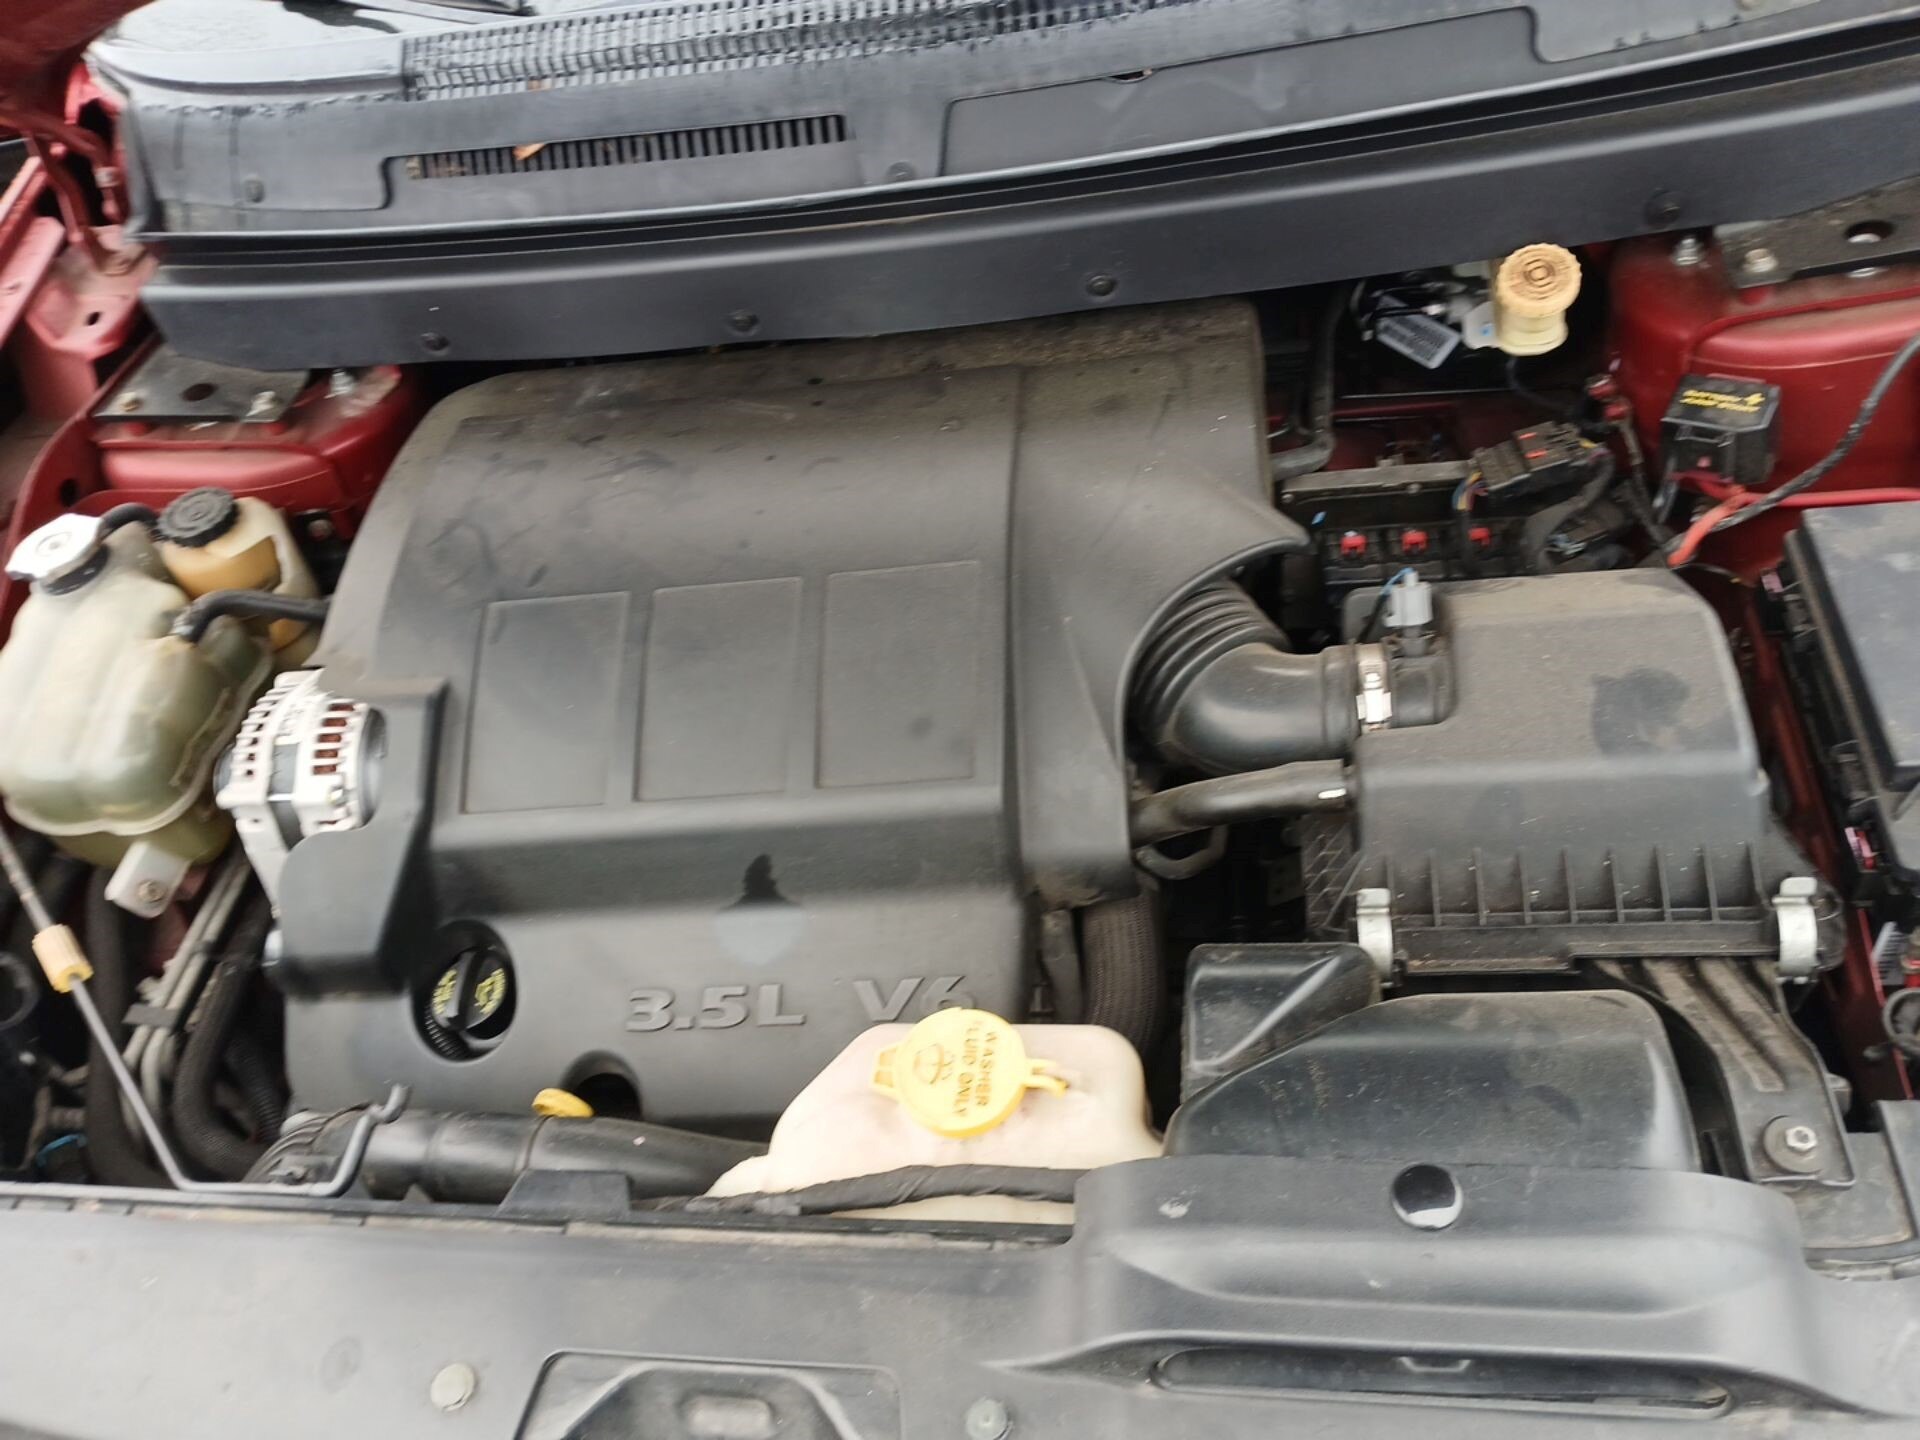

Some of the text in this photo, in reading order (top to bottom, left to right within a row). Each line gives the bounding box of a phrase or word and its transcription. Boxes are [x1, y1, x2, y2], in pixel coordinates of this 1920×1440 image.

[625, 975, 975, 1033] 3.5L V6
[953, 1072, 976, 1118] ONLY
[975, 1030, 998, 1107] WASHER
